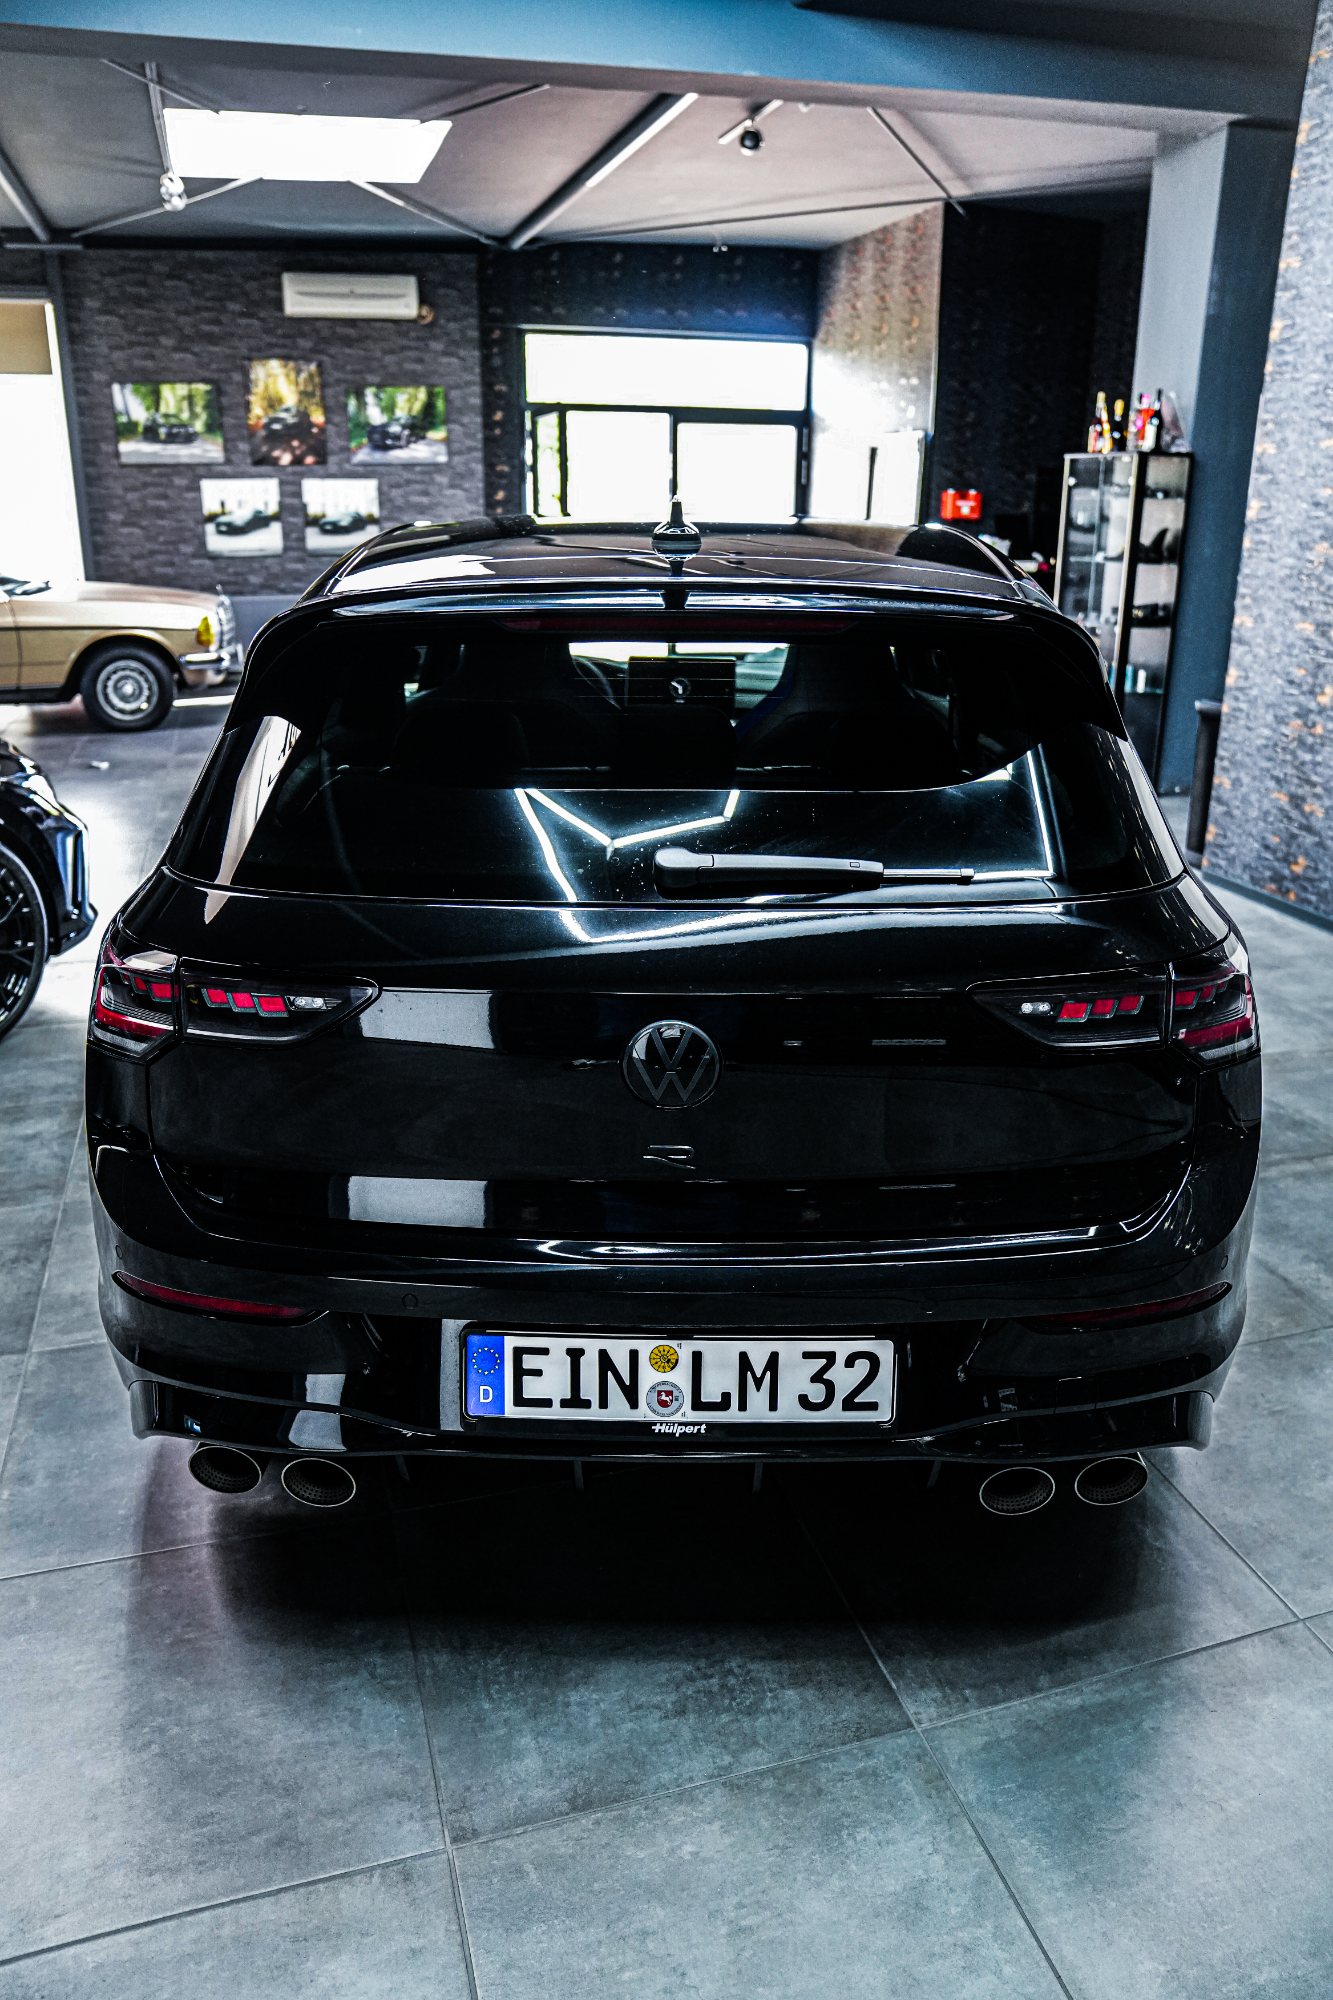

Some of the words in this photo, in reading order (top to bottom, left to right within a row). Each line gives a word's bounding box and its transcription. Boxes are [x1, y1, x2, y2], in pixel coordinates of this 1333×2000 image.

[512, 1346, 639, 1409] EIN
[691, 1350, 780, 1412] LM
[798, 1350, 880, 1412] 32
[479, 1386, 493, 1403] D
[651, 1422, 707, 1436] Hülpert
